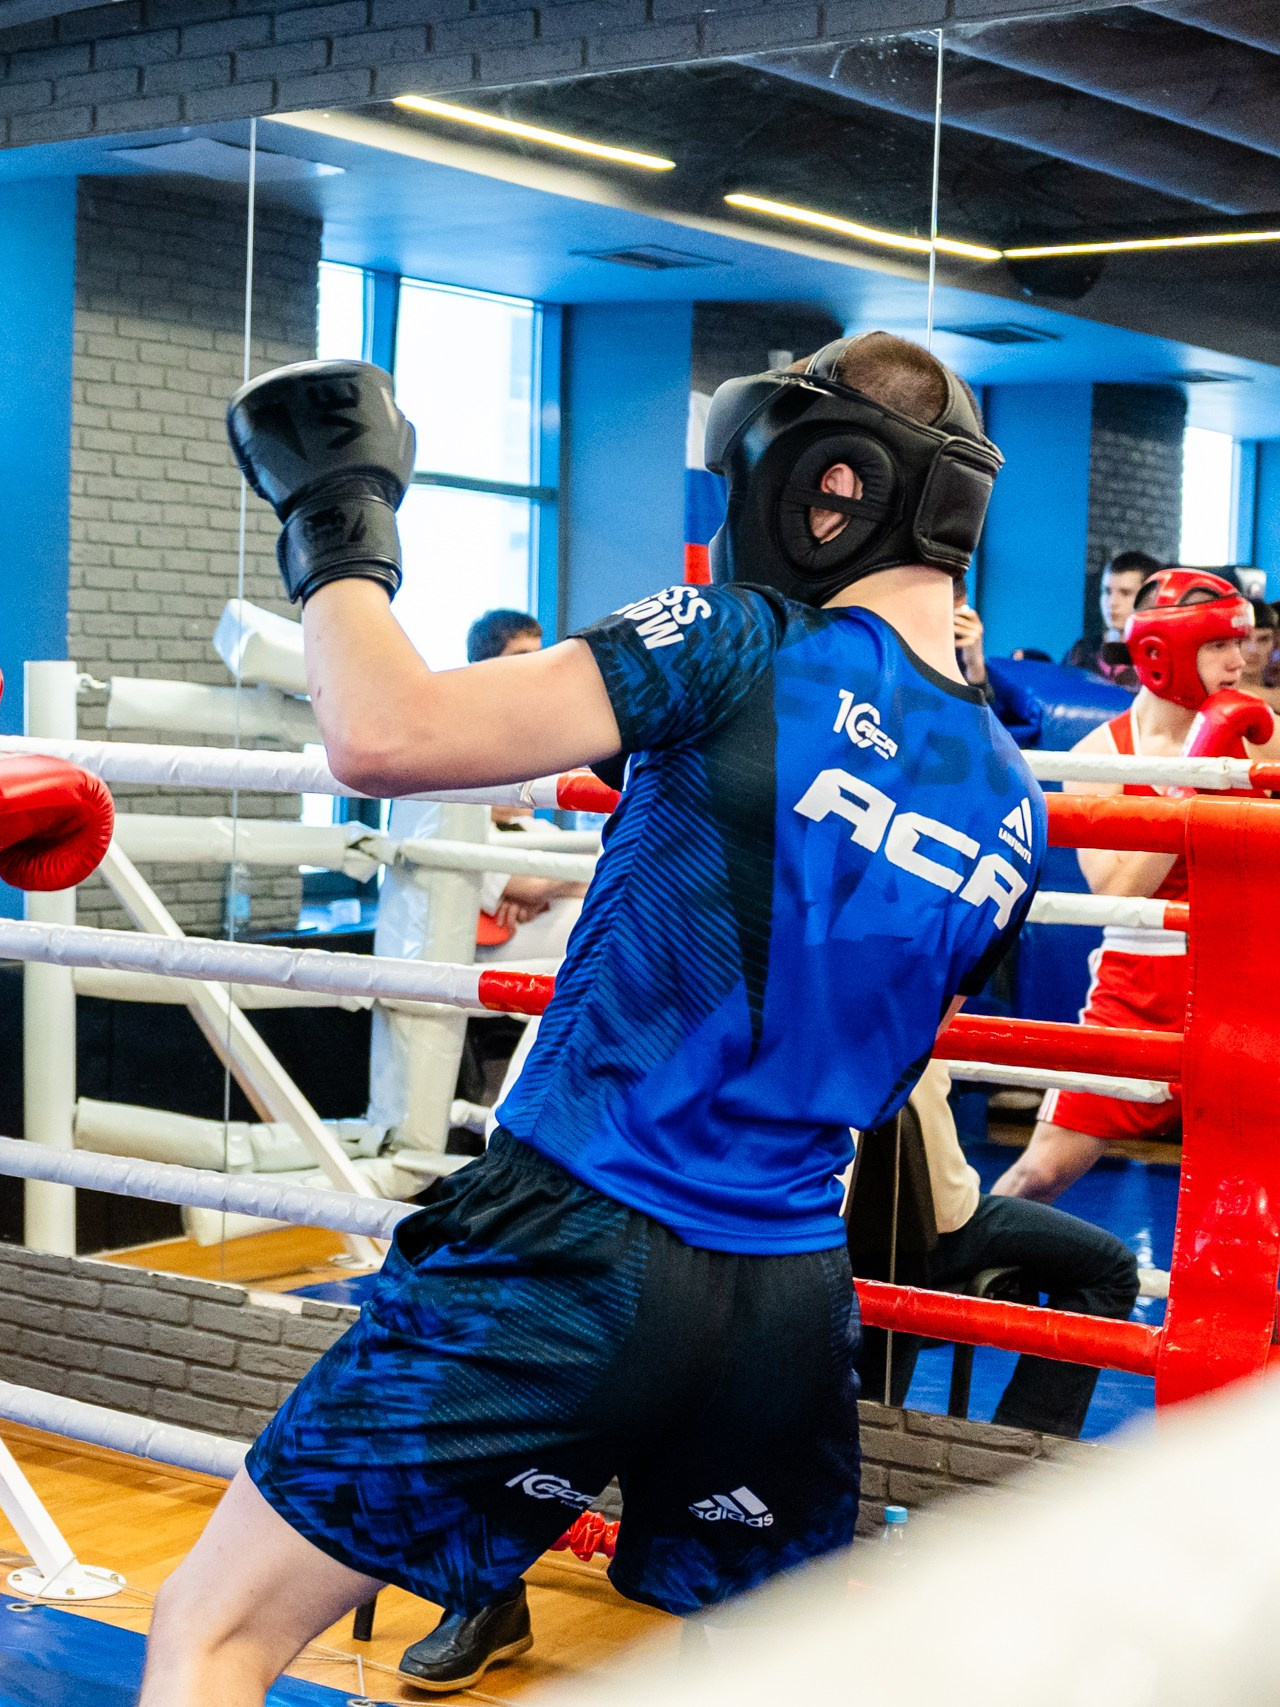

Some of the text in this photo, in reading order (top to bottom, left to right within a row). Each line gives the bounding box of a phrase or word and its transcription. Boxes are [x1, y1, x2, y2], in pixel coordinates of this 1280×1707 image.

[651, 585, 712, 625] SS
[793, 768, 1028, 931] ACA
[688, 1506, 774, 1528] adidas
